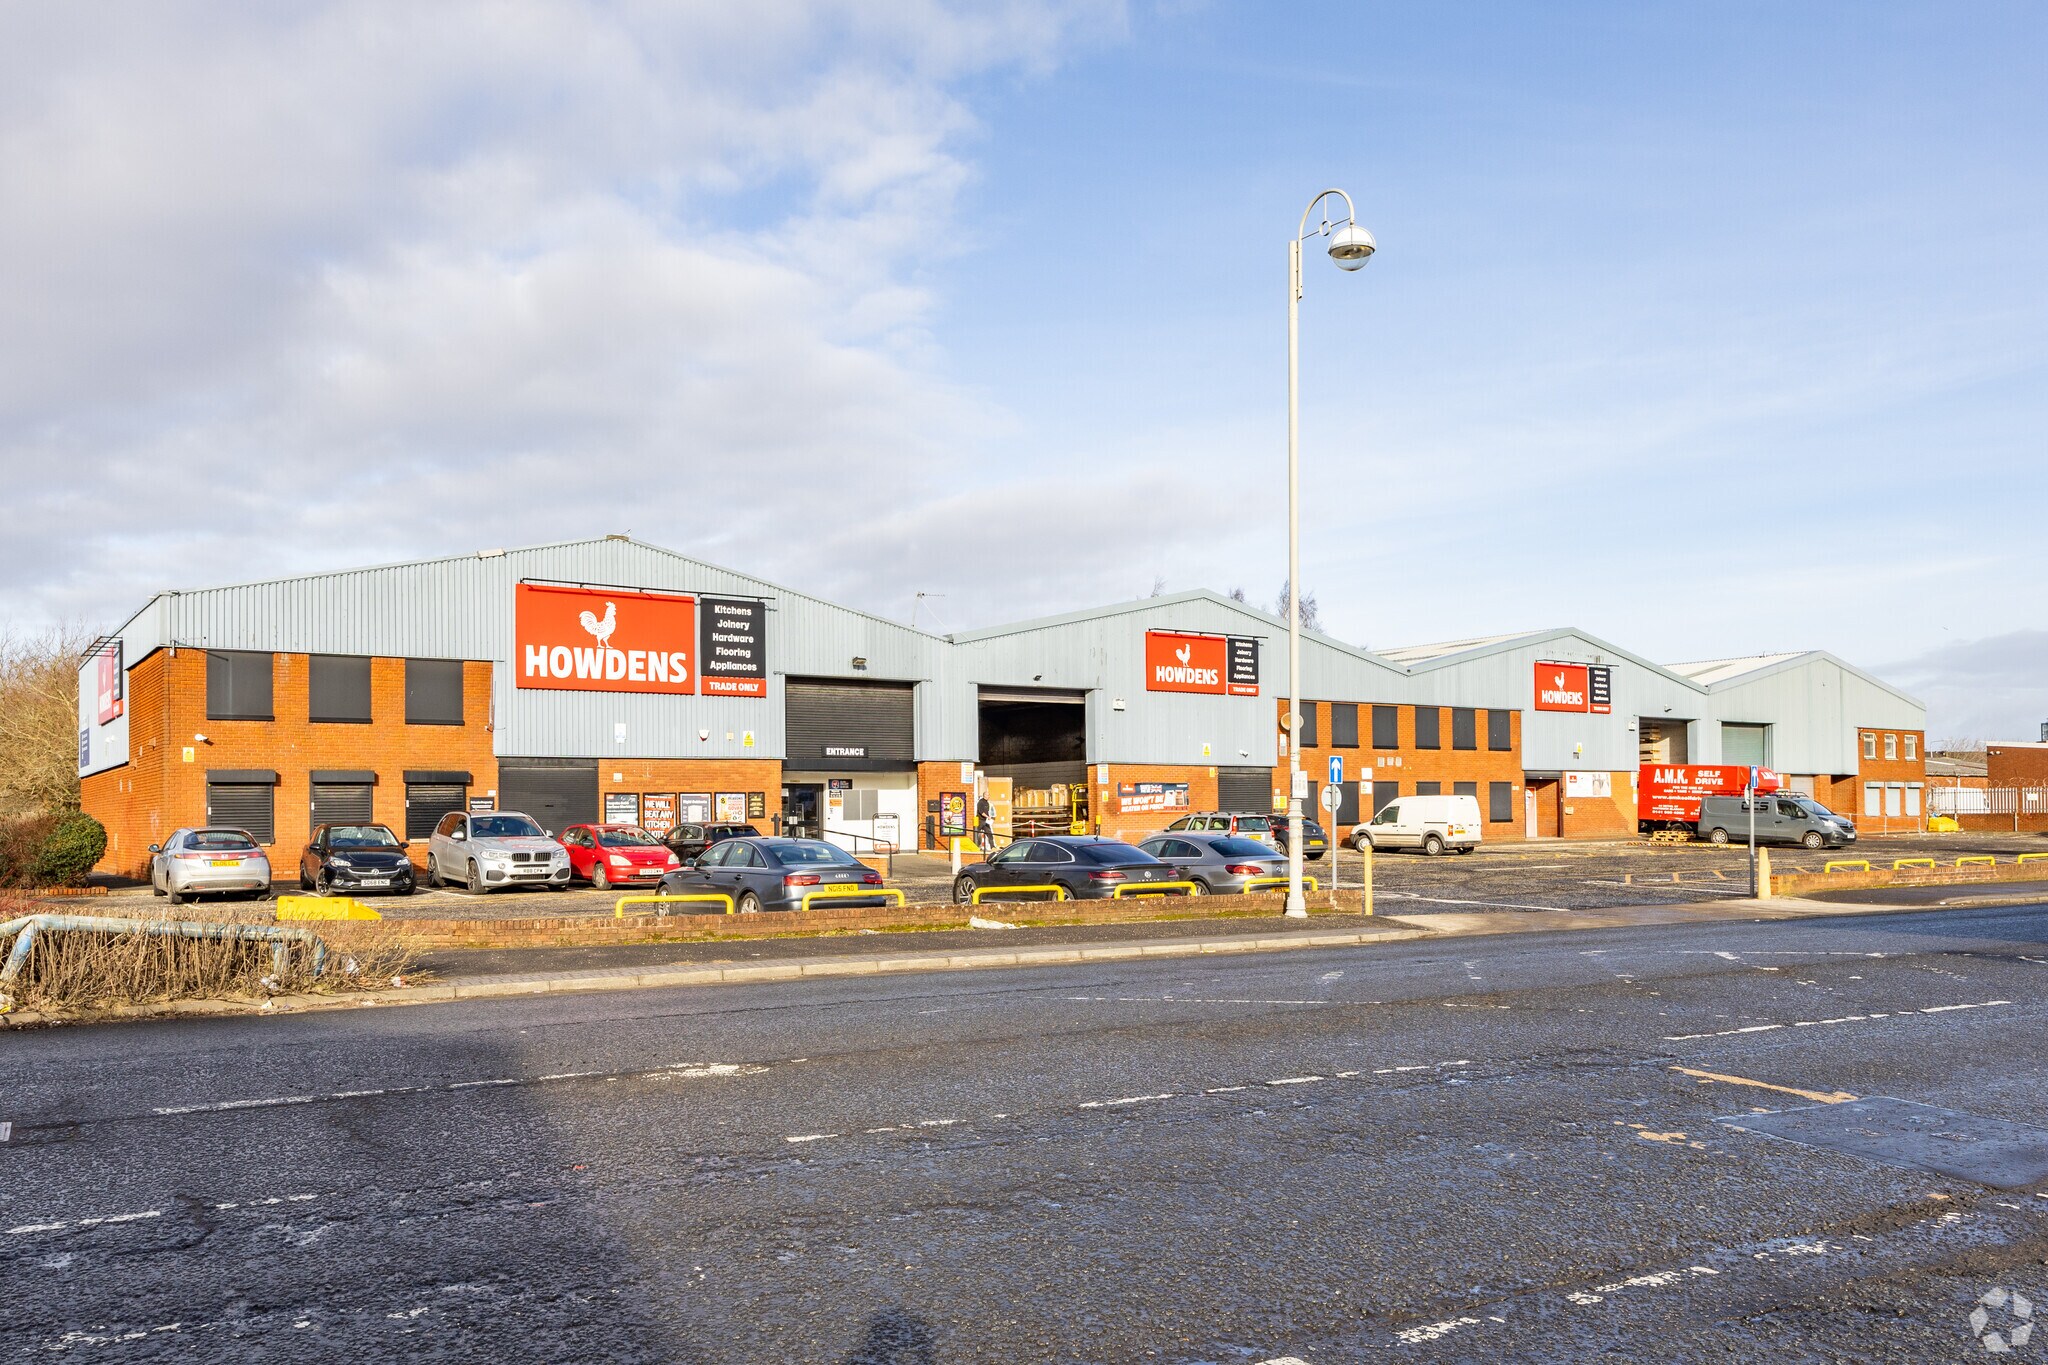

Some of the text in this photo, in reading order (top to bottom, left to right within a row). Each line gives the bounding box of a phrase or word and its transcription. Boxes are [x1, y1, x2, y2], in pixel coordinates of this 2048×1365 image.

[714, 604, 752, 616] Kitchens
[717, 619, 750, 631] Joinery
[712, 632, 754, 644] Hardware
[715, 646, 751, 659] Flooring
[525, 644, 688, 684] HOWDENS
[709, 660, 757, 672] Appliances
[1155, 665, 1219, 685] HOWDENS
[709, 681, 759, 692] TRADE ONLY
[1541, 689, 1583, 705] HOWDENS
[826, 747, 865, 756] ENTRANCE
[1653, 768, 1689, 784] A.M.K.
[1697, 770, 1721, 778] SELF
[1695, 777, 1724, 785] DRIVE
[644, 800, 656, 808] WE
[655, 800, 671, 808] WILL
[644, 810, 674, 819] BEAT ANY
[644, 820, 671, 828] KITCHEN
